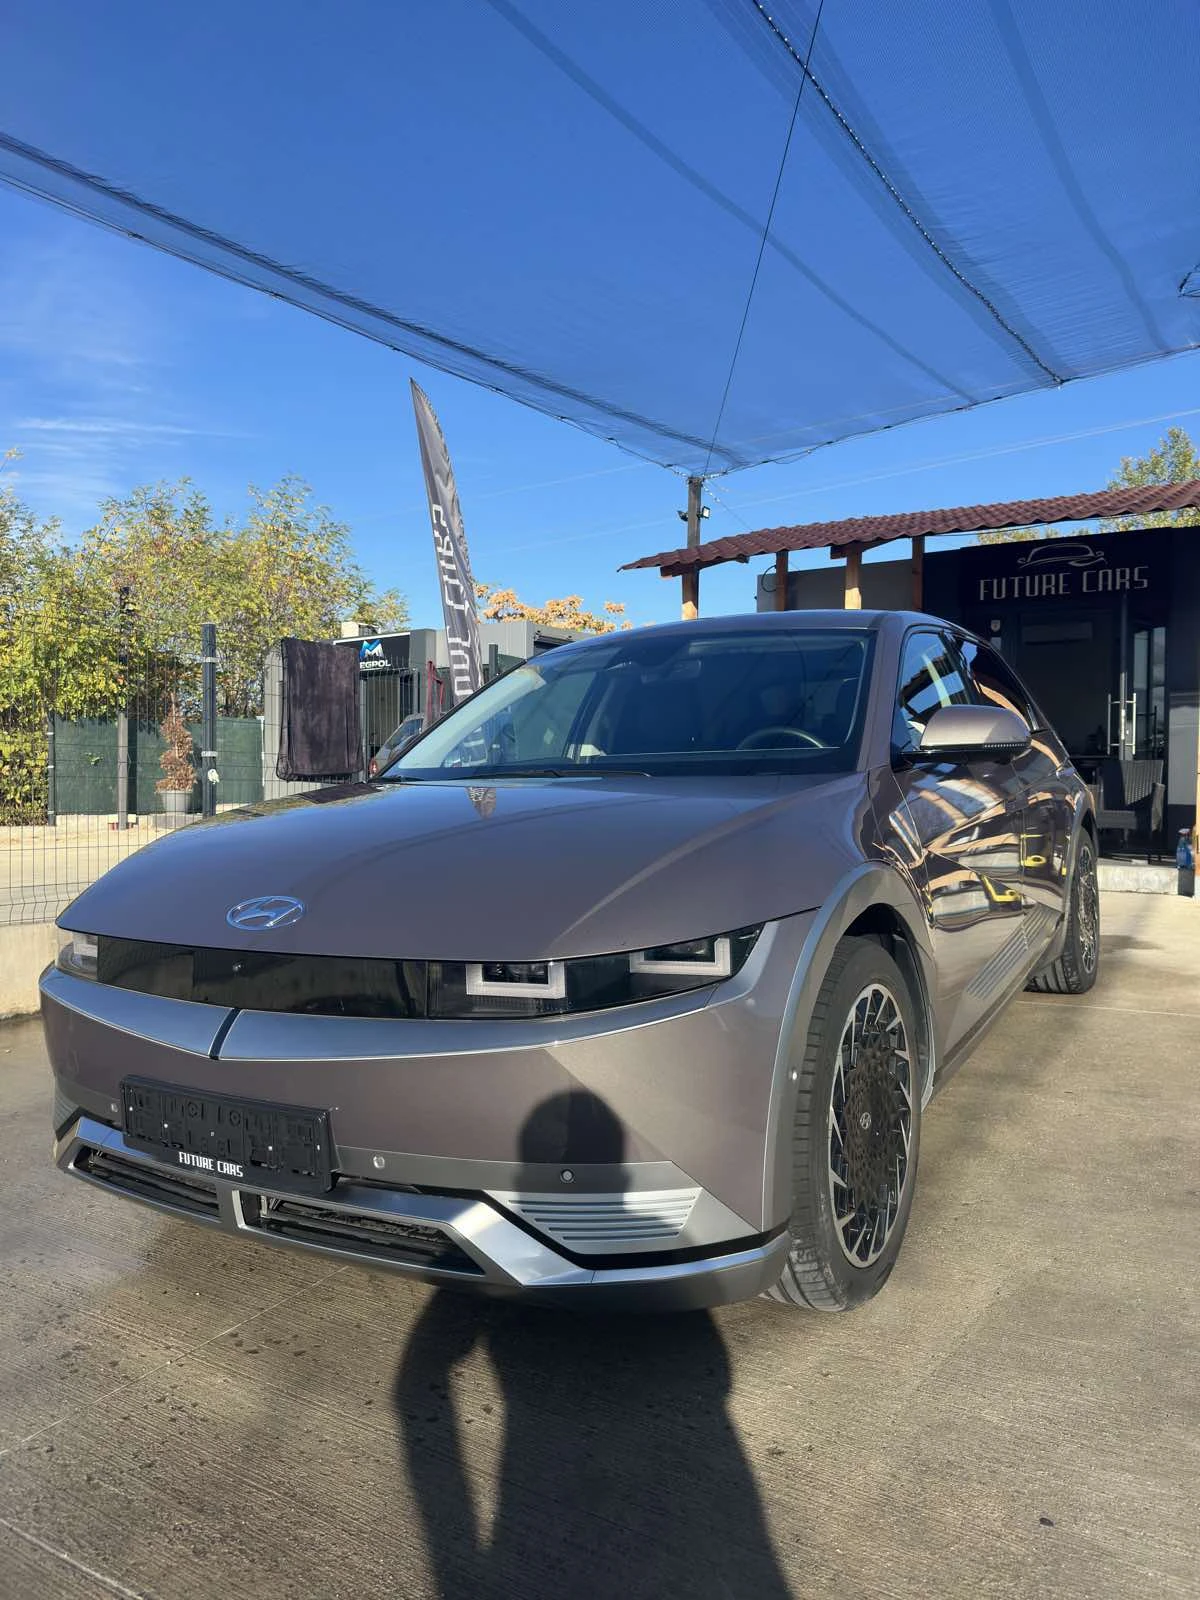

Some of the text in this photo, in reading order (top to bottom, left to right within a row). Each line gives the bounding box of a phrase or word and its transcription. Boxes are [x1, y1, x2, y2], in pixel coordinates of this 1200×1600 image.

[979, 566, 1149, 601] FUTURE CARS
[359, 659, 391, 669] EGPOL
[178, 1151, 244, 1178] FUTURE CARS
